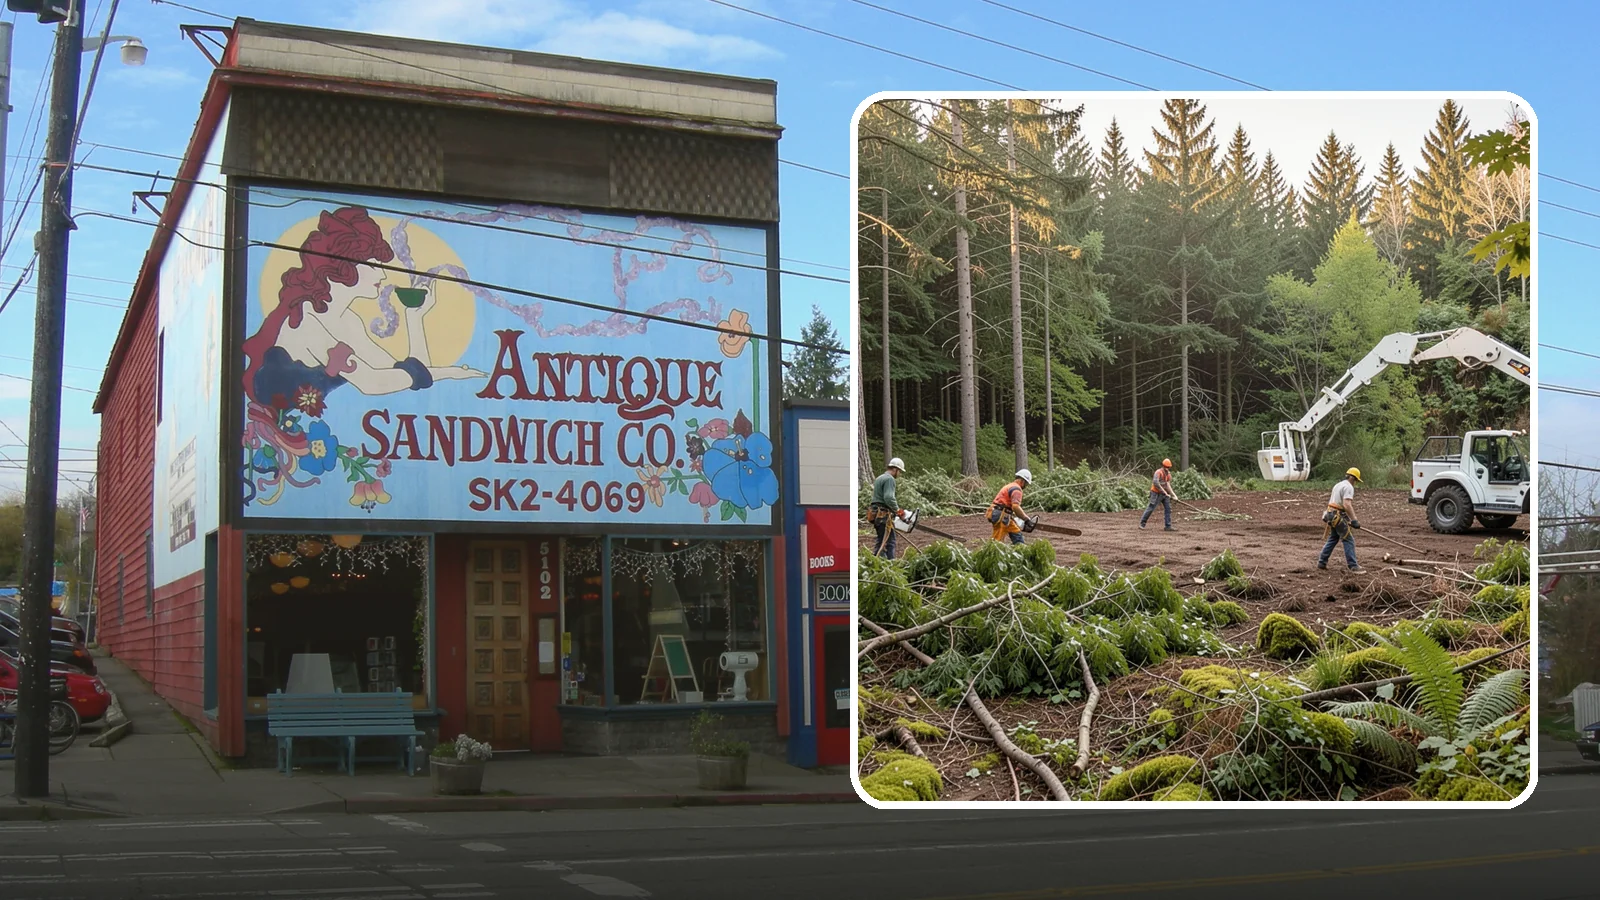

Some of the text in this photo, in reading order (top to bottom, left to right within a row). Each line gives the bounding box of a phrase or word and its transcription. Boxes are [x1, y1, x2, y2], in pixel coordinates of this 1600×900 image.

[475, 329, 724, 420] ANTIQUE
[361, 408, 685, 469] SANDWICH CO.
[469, 477, 646, 513] SK2-4069
[540, 541, 552, 599] 5102
[809, 555, 835, 569] BOOKS
